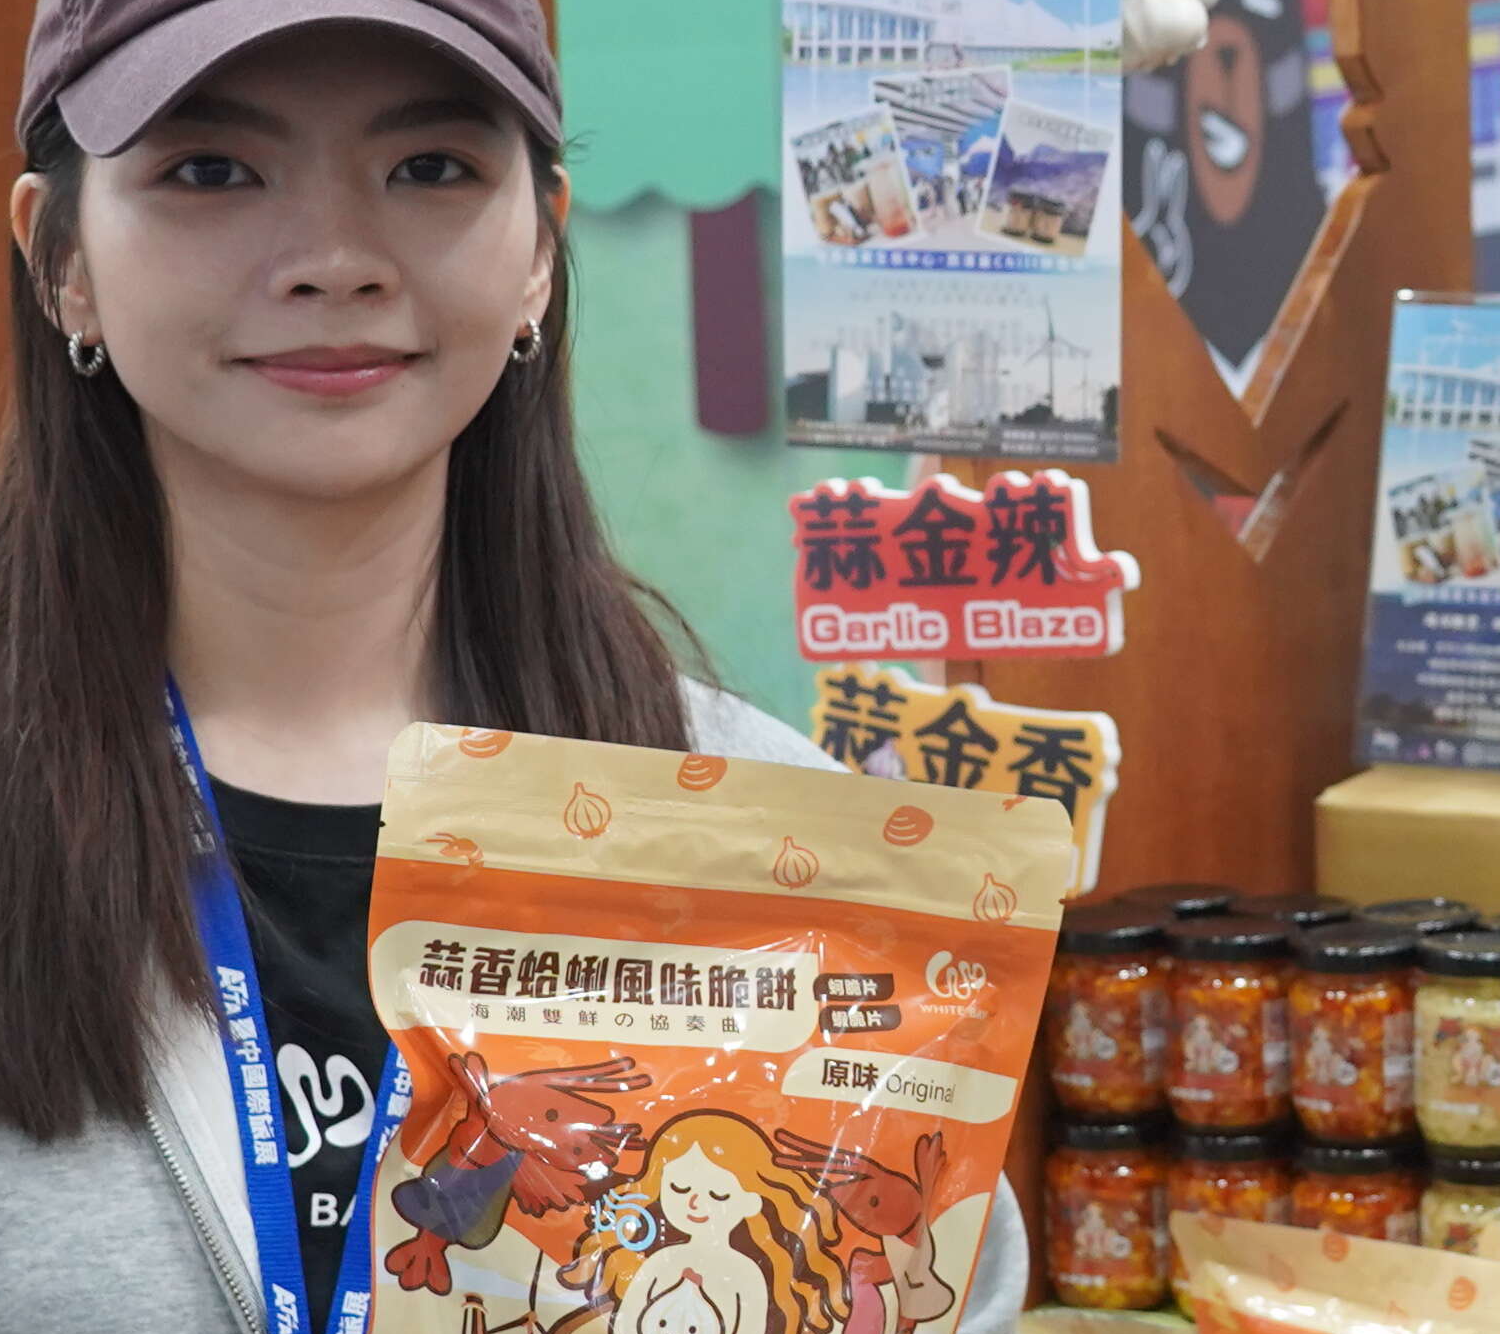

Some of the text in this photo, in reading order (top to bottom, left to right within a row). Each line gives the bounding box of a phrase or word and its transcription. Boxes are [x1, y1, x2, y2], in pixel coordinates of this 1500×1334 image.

[798, 484, 1070, 590] 蒜金辣
[808, 609, 1101, 645] Garlic Blaze
[420, 939, 799, 1013] 蒜香蛤蜊風味脆餅
[469, 1002, 742, 1037] 海潮雙鮮の協奏曲
[919, 1002, 967, 1017] WHITE
[820, 1056, 955, 1107] 原味 Original
